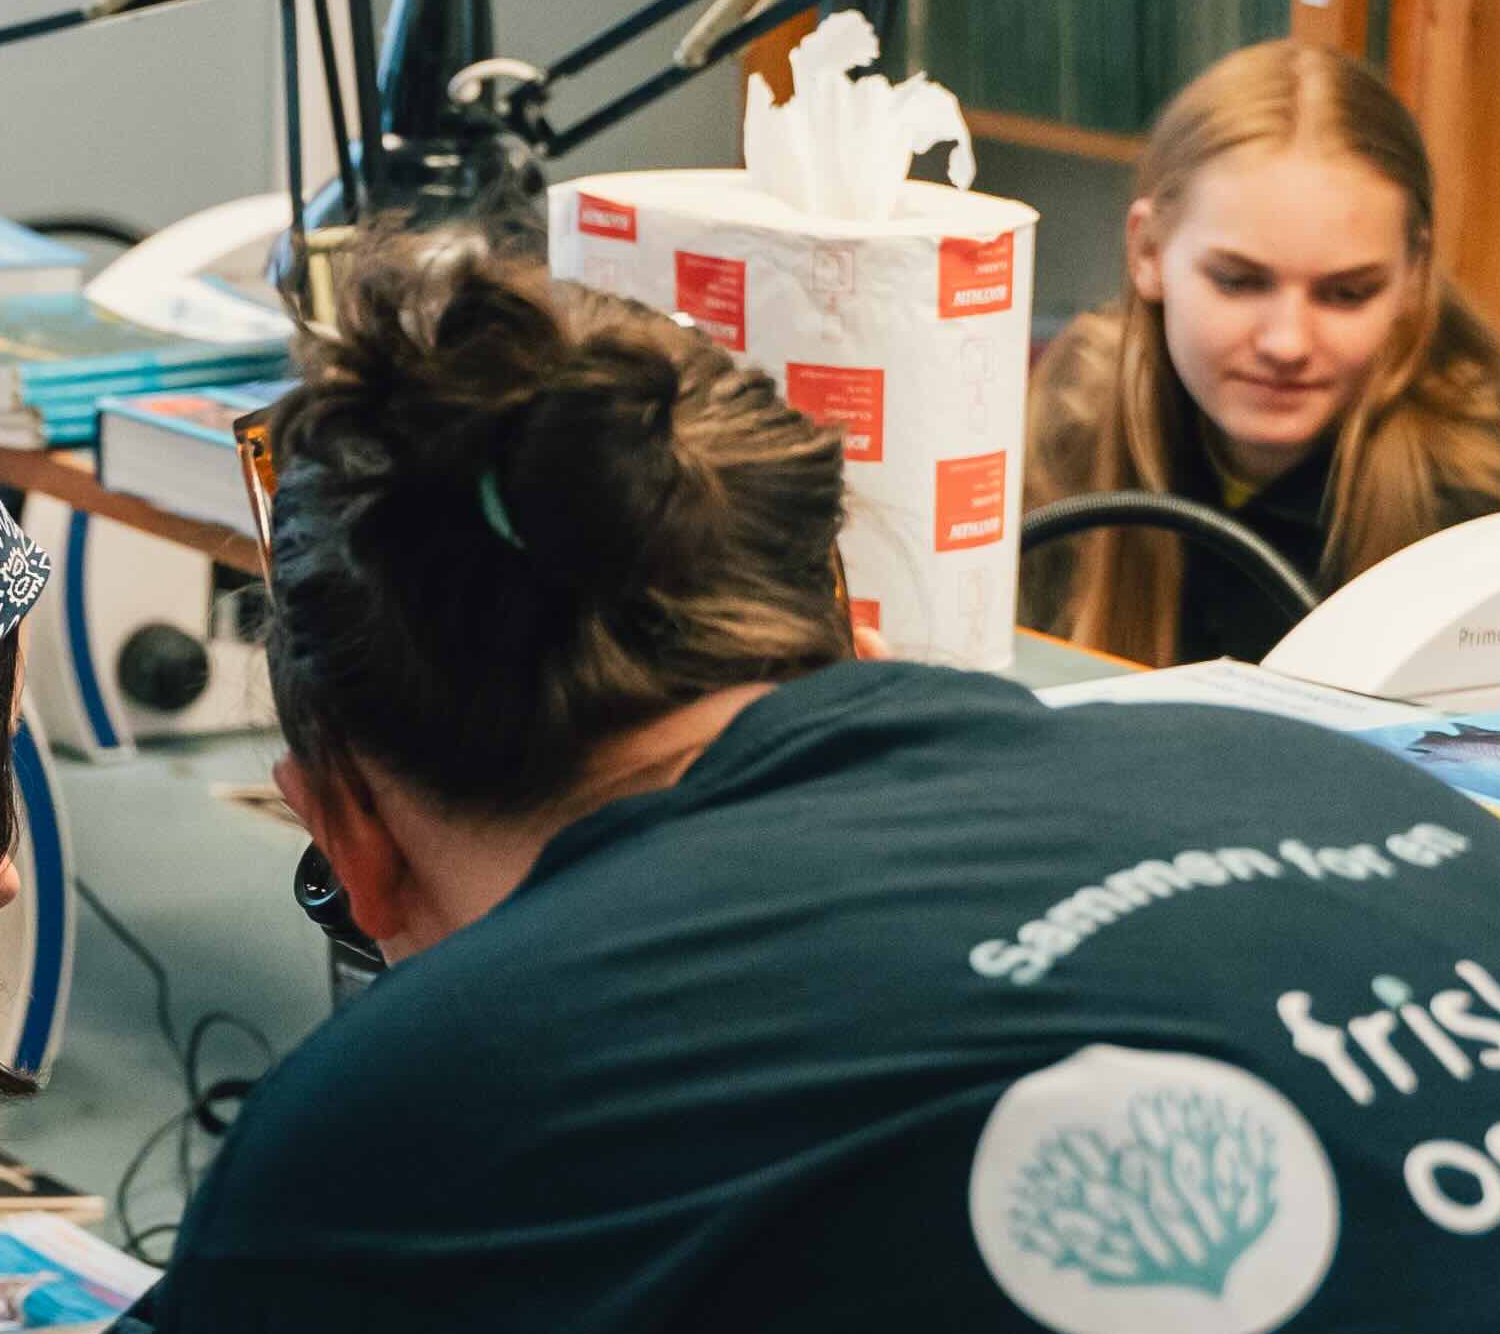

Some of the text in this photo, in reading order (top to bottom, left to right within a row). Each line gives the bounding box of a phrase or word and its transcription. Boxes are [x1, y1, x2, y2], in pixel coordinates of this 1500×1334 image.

[969, 822, 1471, 986] Sammen for en
